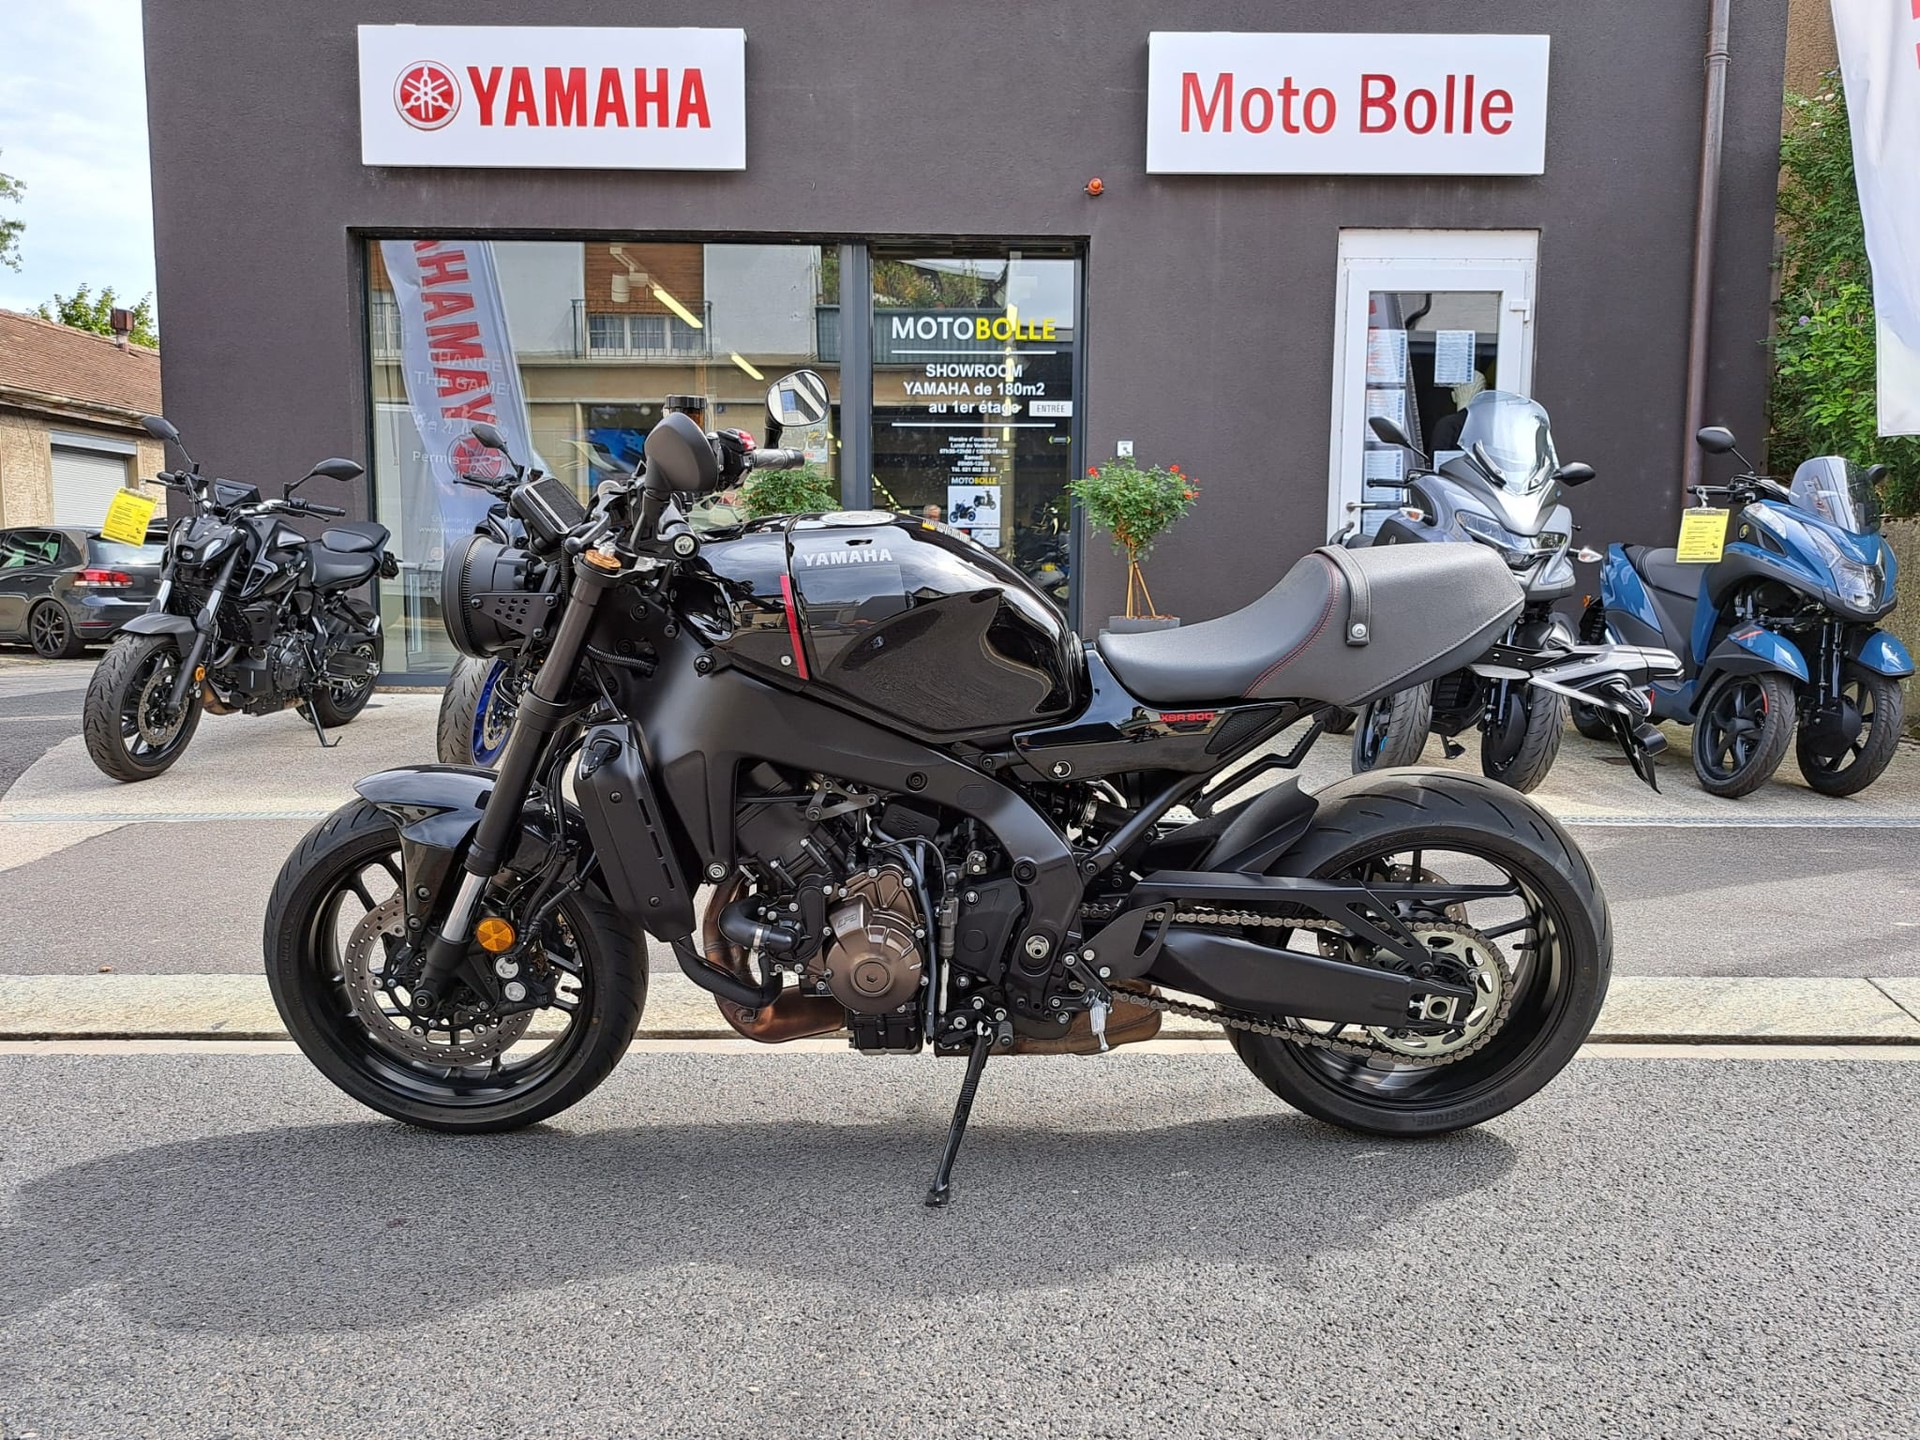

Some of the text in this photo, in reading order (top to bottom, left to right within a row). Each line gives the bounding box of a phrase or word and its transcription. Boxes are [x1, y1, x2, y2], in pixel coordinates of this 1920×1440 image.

[466, 66, 712, 128] YAMAHA
[1181, 72, 1514, 136] Moto Bolle
[891, 316, 1057, 341] MOTOBOLLE
[428, 350, 503, 373] CHANGE
[414, 370, 453, 389] THE
[925, 364, 1023, 378] SHOWROOM
[903, 381, 1046, 396] YAMAHA de 180m2
[928, 401, 1020, 417] au 1er étage
[1036, 402, 1066, 413] ENTRÉE
[412, 450, 461, 467] Permis
[951, 476, 998, 485] MOTOBOLLE
[802, 548, 893, 567] YAMAHA
